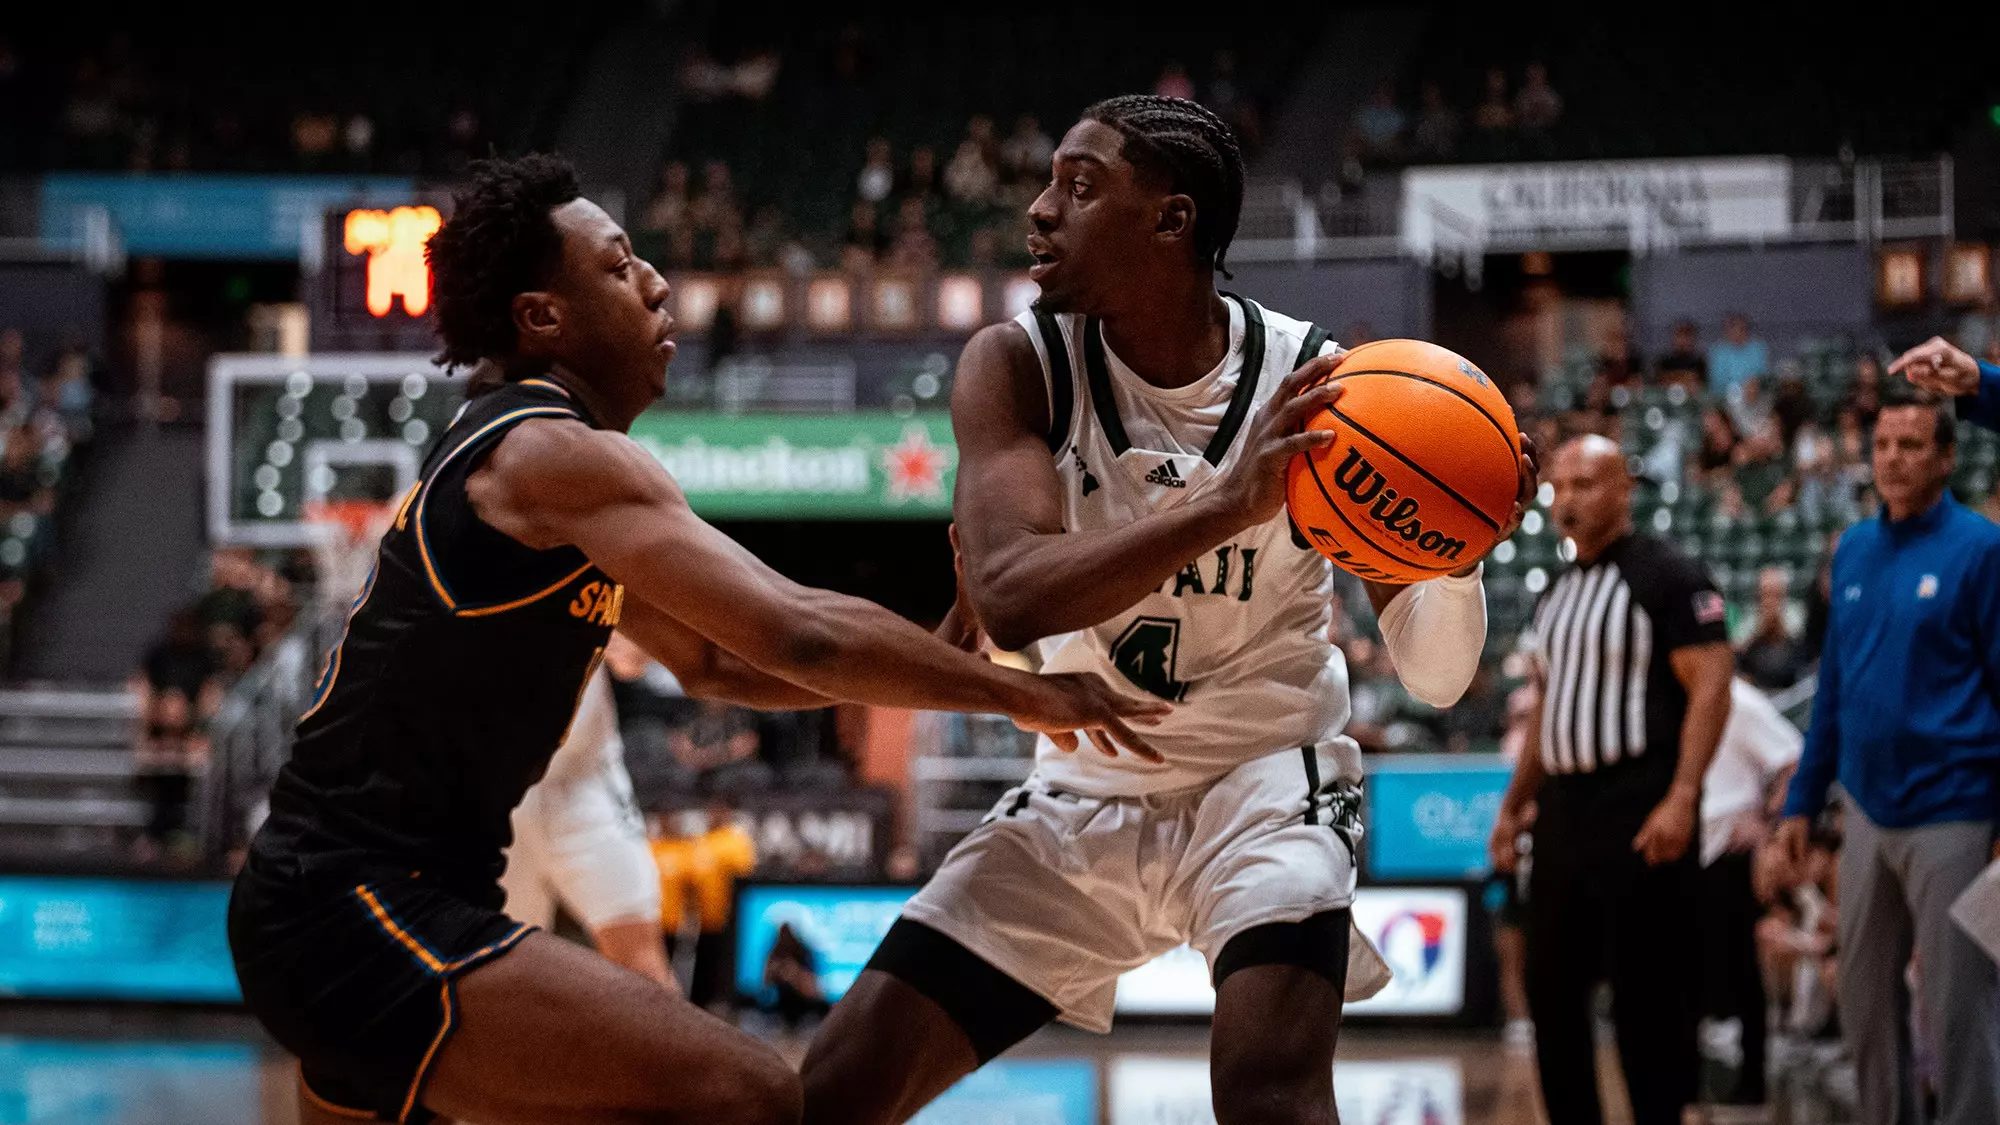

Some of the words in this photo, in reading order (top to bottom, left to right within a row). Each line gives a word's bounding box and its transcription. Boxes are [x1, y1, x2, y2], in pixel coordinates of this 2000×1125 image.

[634, 435, 868, 492] eineken
[1145, 473, 1186, 488] adidas
[1334, 445, 1467, 560] Wilson
[1109, 615, 1191, 703] 4
